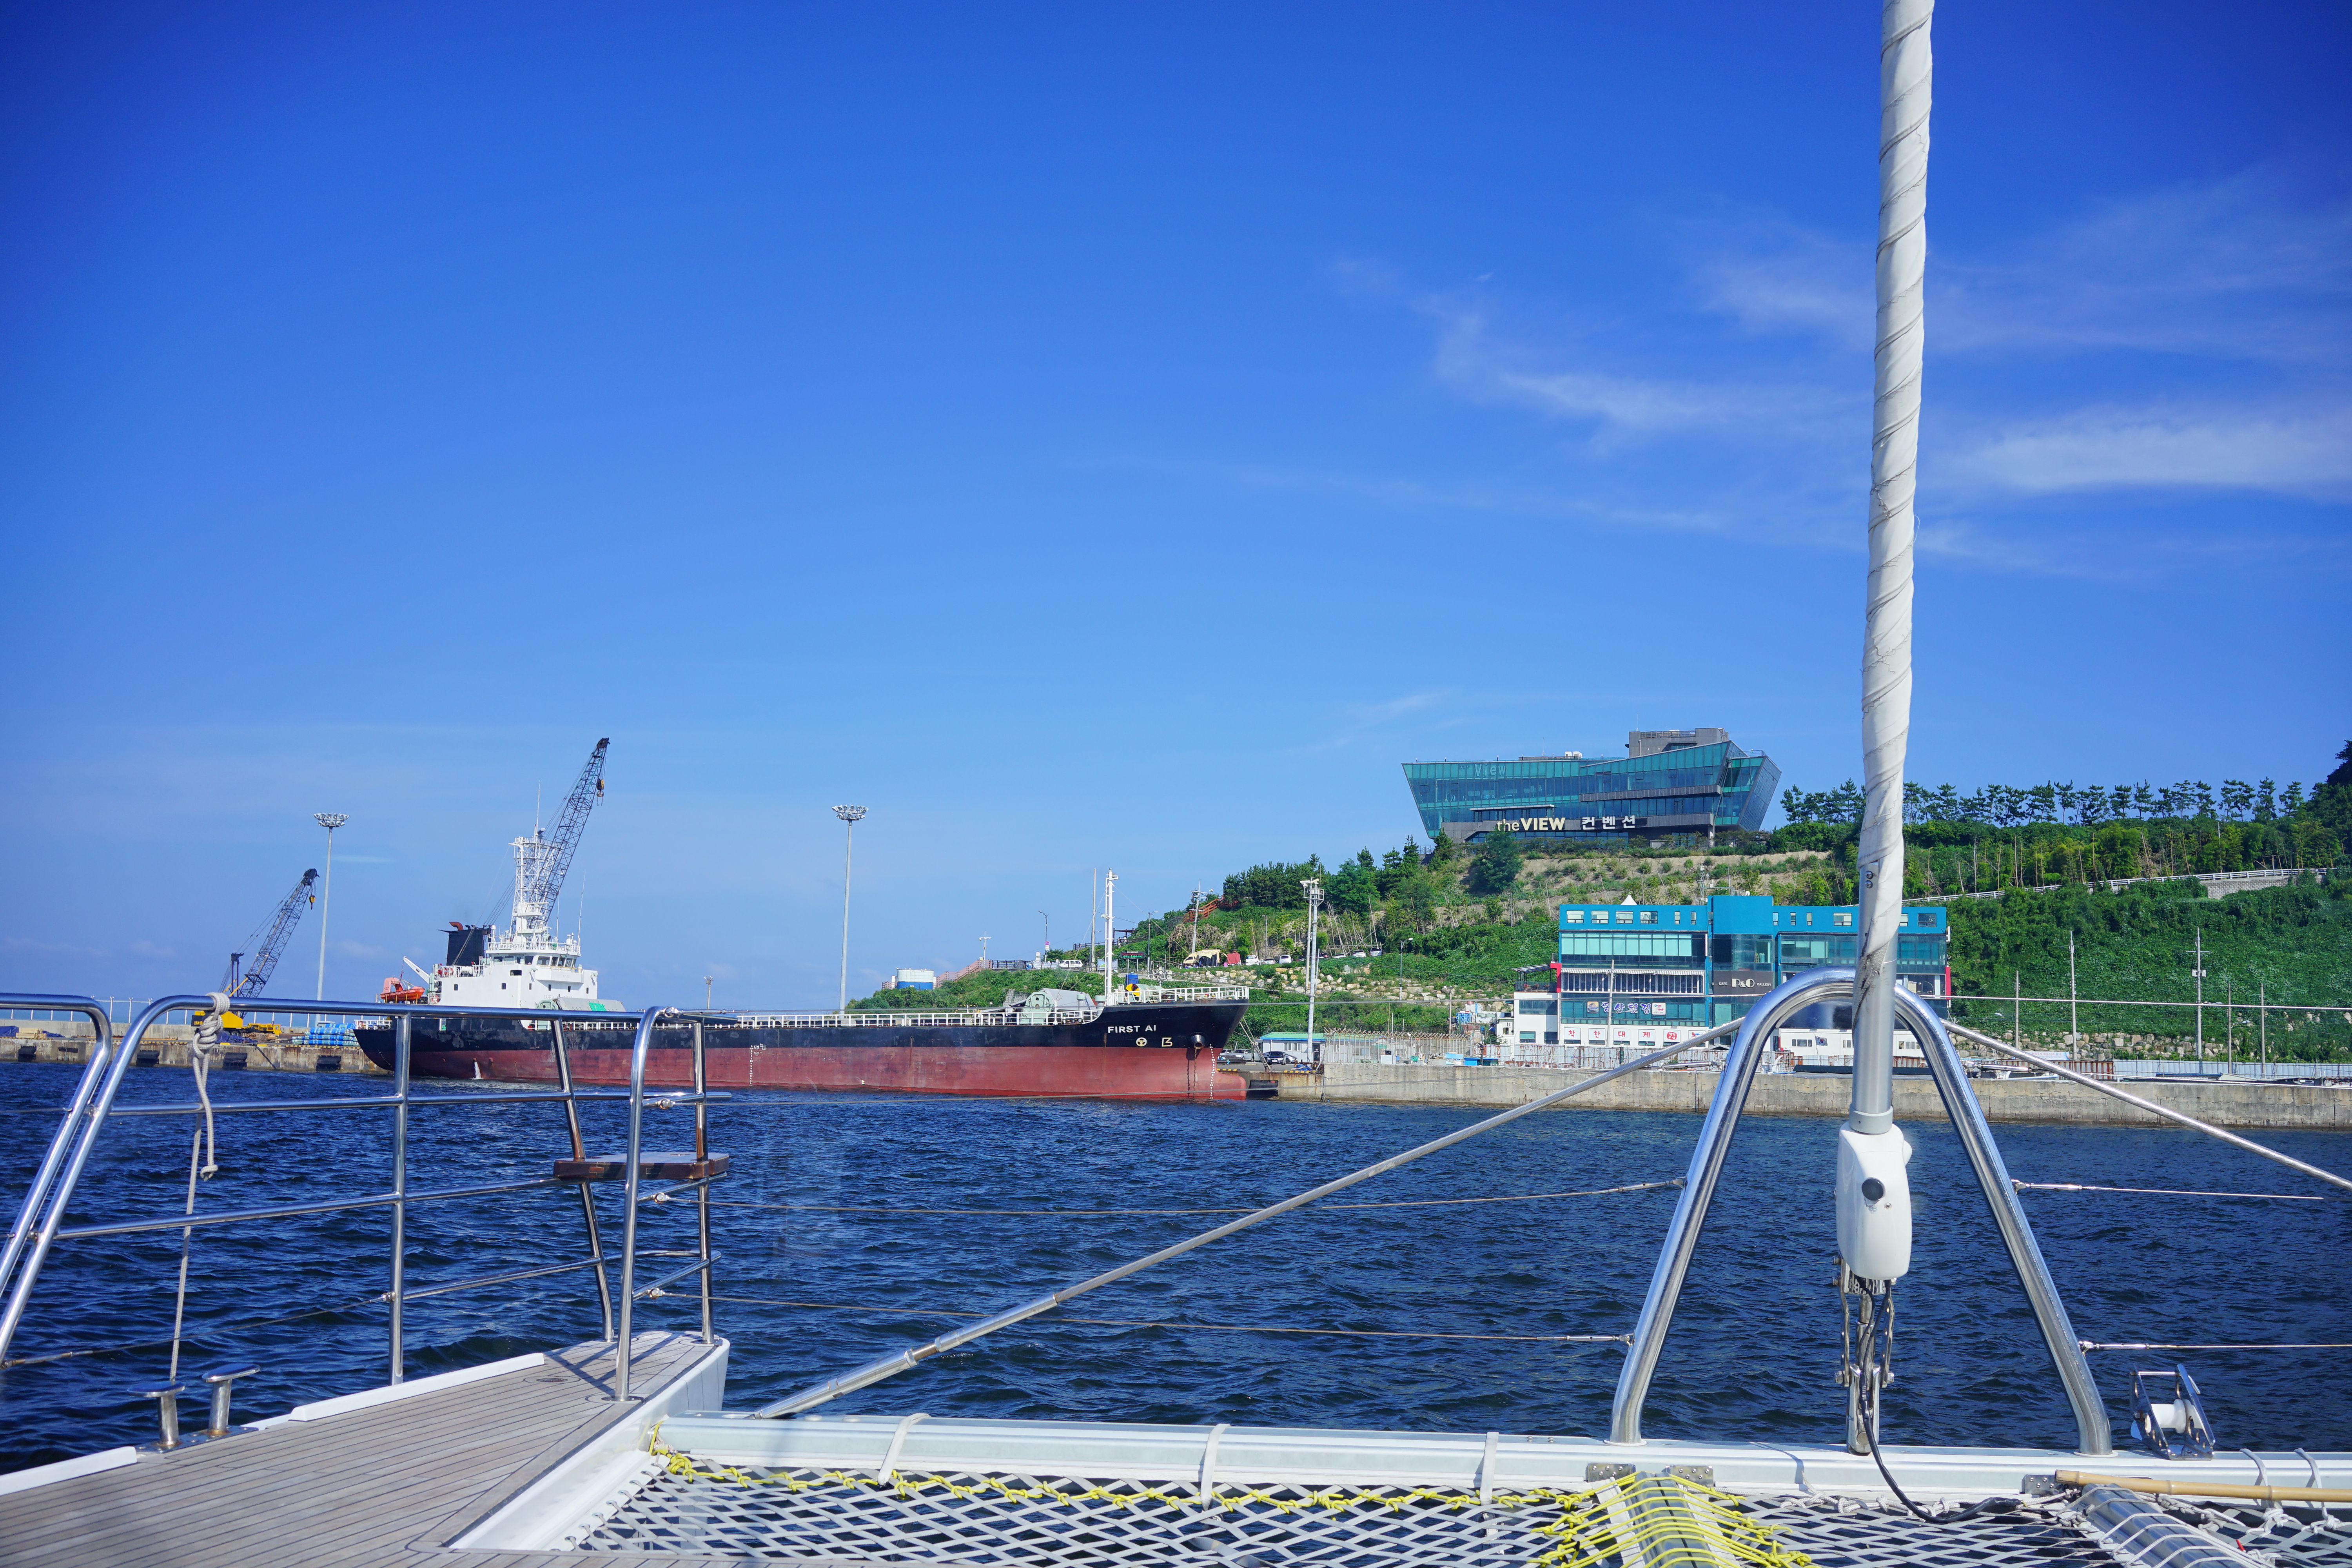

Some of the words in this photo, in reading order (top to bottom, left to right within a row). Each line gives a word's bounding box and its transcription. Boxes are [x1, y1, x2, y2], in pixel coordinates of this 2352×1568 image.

[1475, 764, 1506, 777] View
[1582, 815, 1635, 830] 컨벤션
[1731, 978, 1755, 988] P&O
